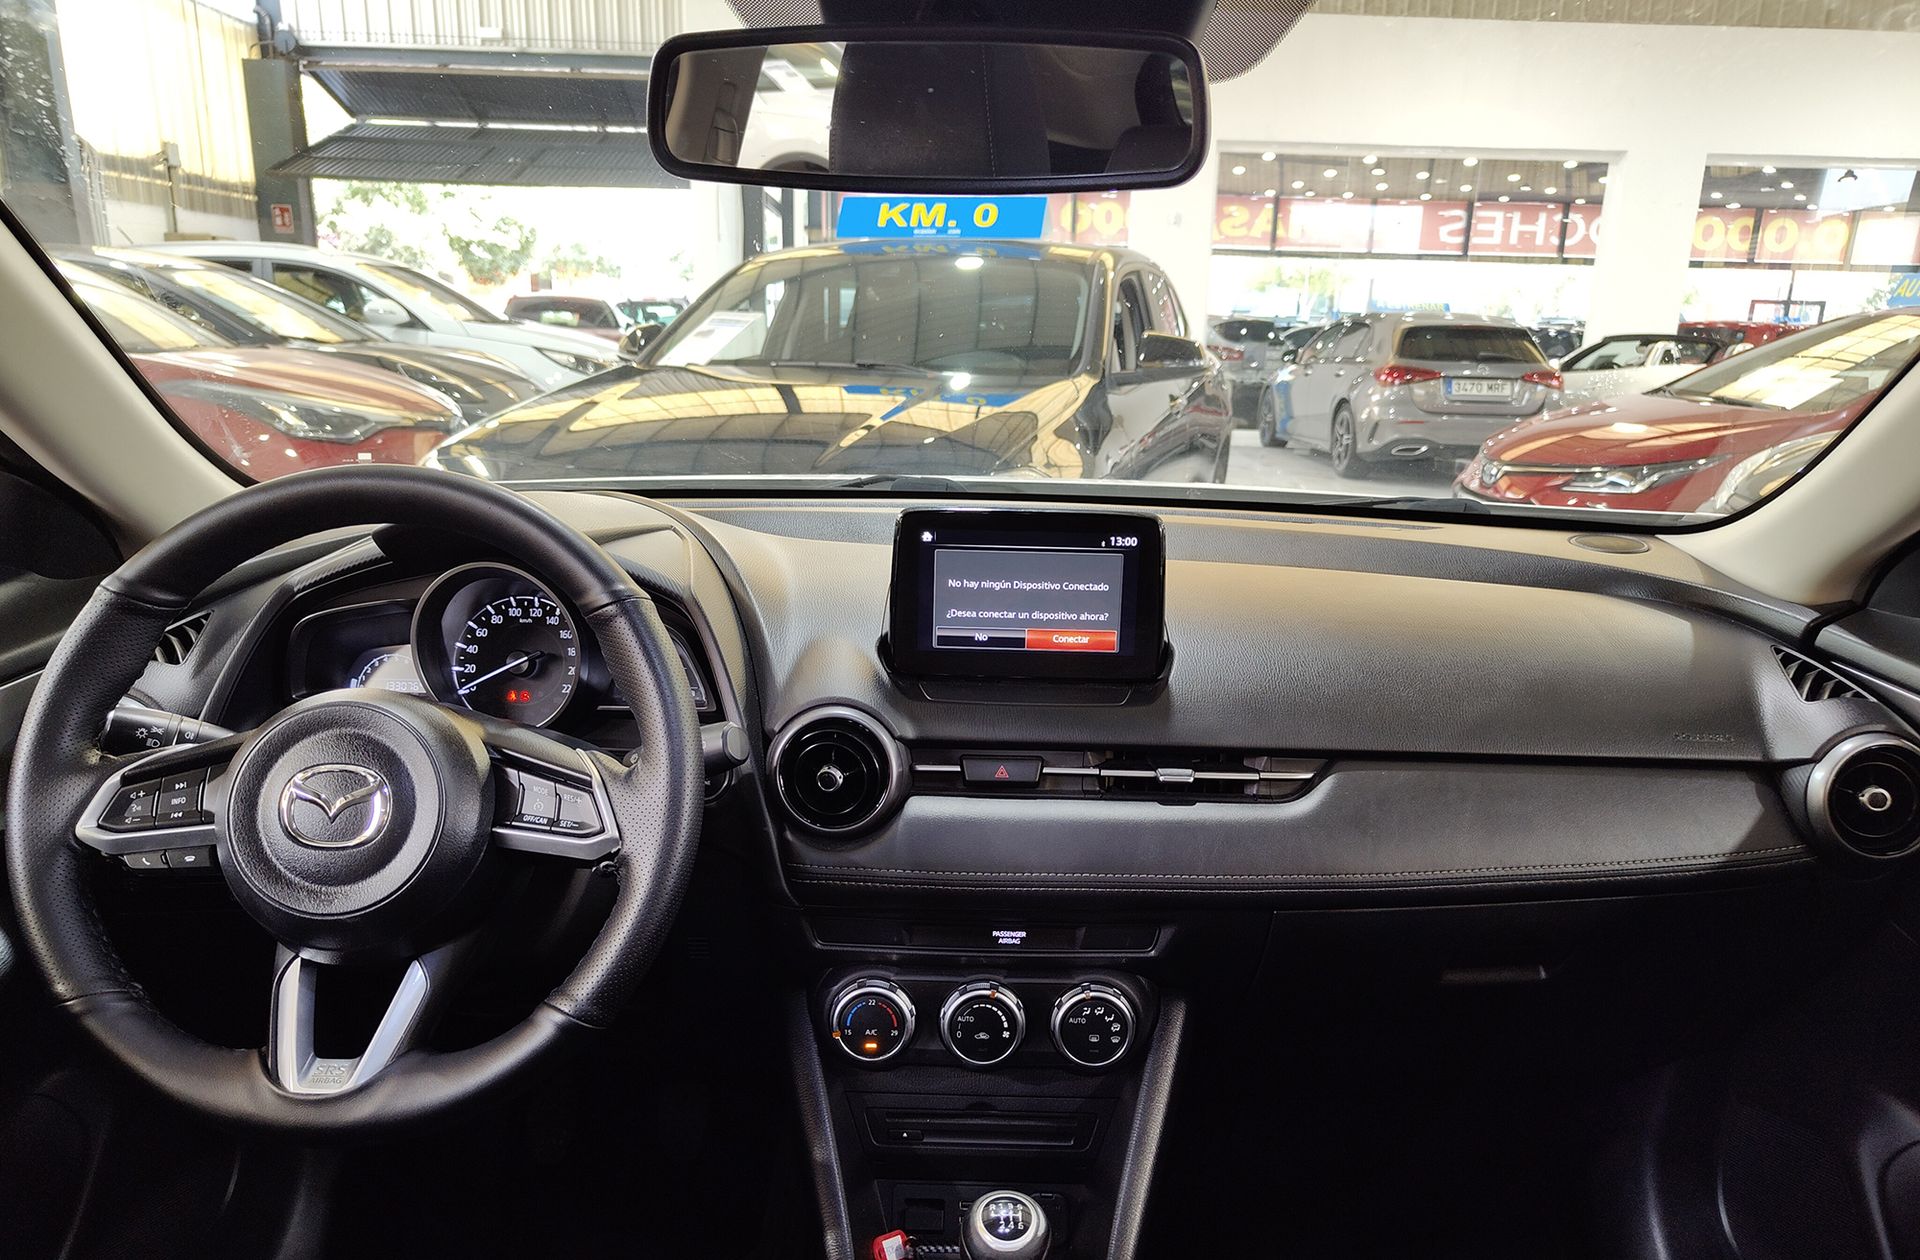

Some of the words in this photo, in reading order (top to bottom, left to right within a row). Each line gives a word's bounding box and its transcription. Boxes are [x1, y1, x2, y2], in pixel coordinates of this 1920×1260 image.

[877, 202, 957, 228] KM.
[973, 202, 999, 228] 0
[1109, 536, 1138, 547] 13:00
[948, 579, 962, 588] No
[963, 579, 979, 590] hay
[981, 579, 1011, 591] ningún
[1013, 580, 1061, 591] Dispositivo
[1062, 582, 1109, 592] Conectado
[508, 608, 522, 617] 100
[529, 608, 542, 617] 120
[946, 608, 977, 619] ¿Desea
[978, 610, 1016, 620] conectar
[1018, 612, 1030, 620] un
[1031, 611, 1078, 622] dispositivo
[1079, 612, 1109, 622] ahora?
[490, 615, 503, 624] 80
[546, 616, 559, 625] 140
[475, 628, 488, 637] 60
[974, 632, 988, 641] No
[1052, 634, 1090, 644] Conectar
[466, 645, 478, 654] 40
[464, 664, 476, 673] 20
[171, 797, 187, 805] INFO
[314, 1064, 348, 1075] SRS
